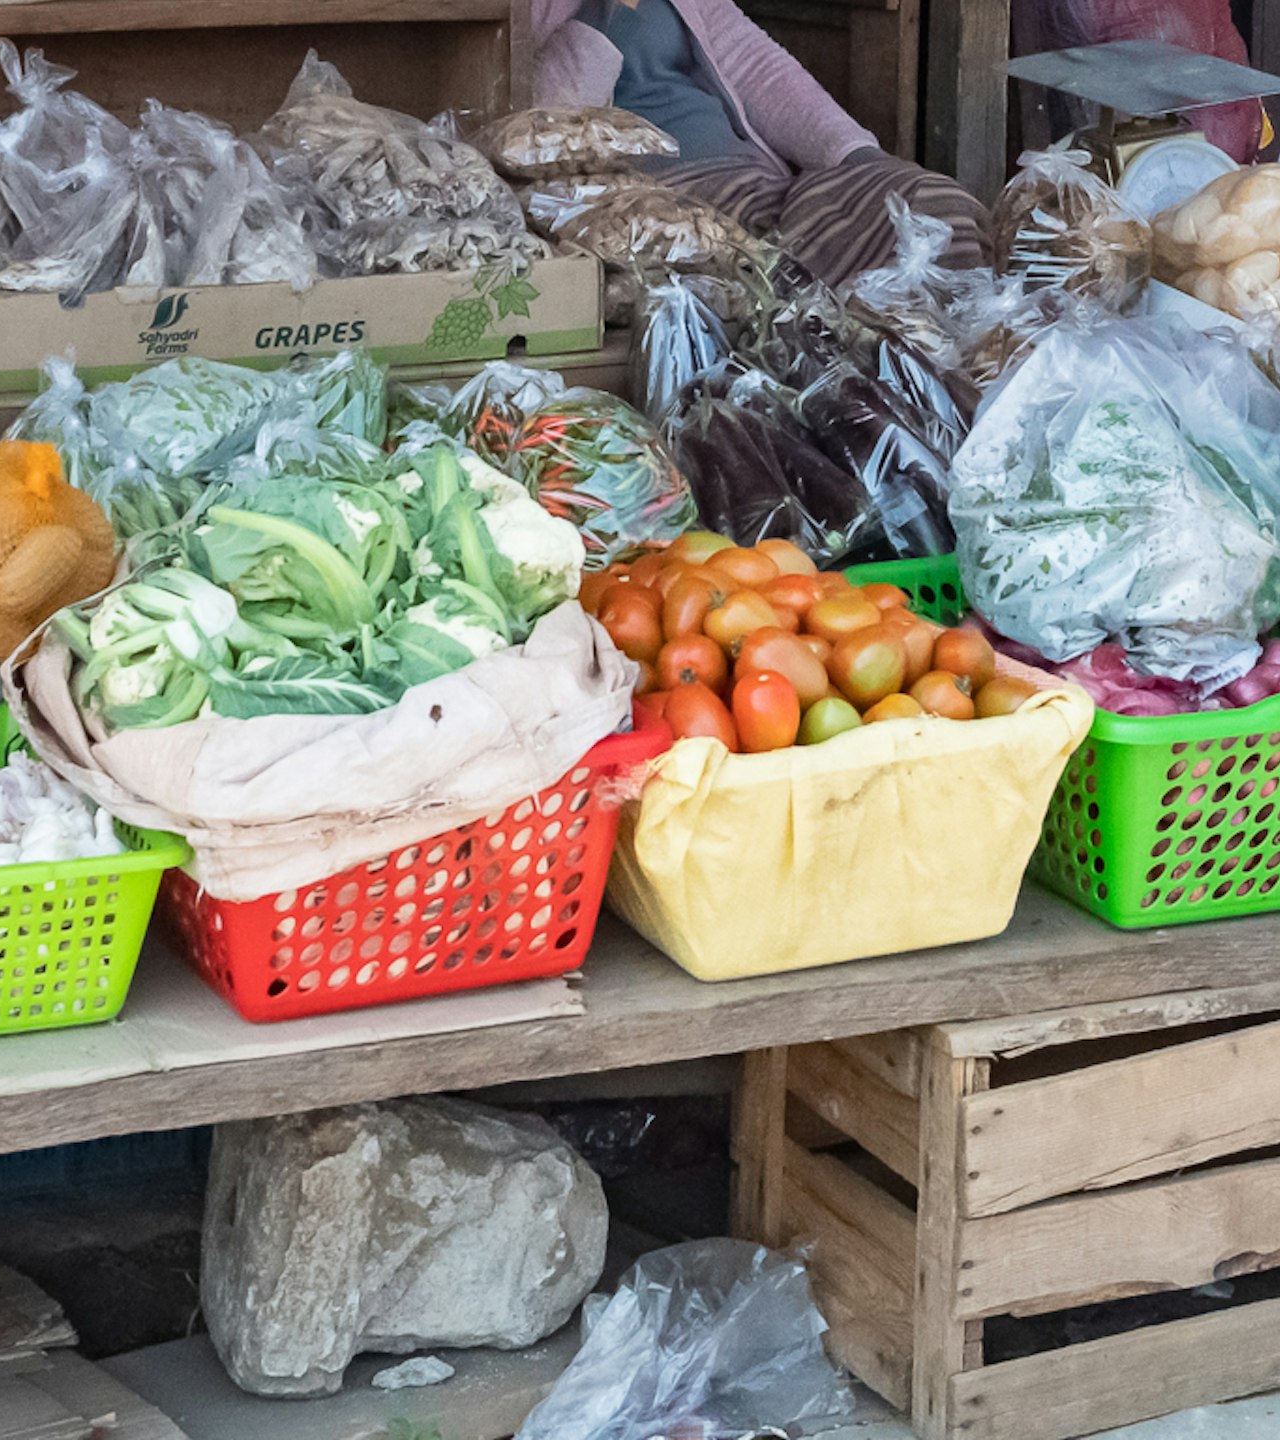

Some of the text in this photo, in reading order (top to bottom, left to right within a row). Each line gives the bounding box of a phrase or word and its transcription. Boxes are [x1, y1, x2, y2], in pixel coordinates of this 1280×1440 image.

[137, 327, 200, 346] Sahyadri
[255, 319, 366, 351] GRAPES
[146, 342, 189, 355] Farms
